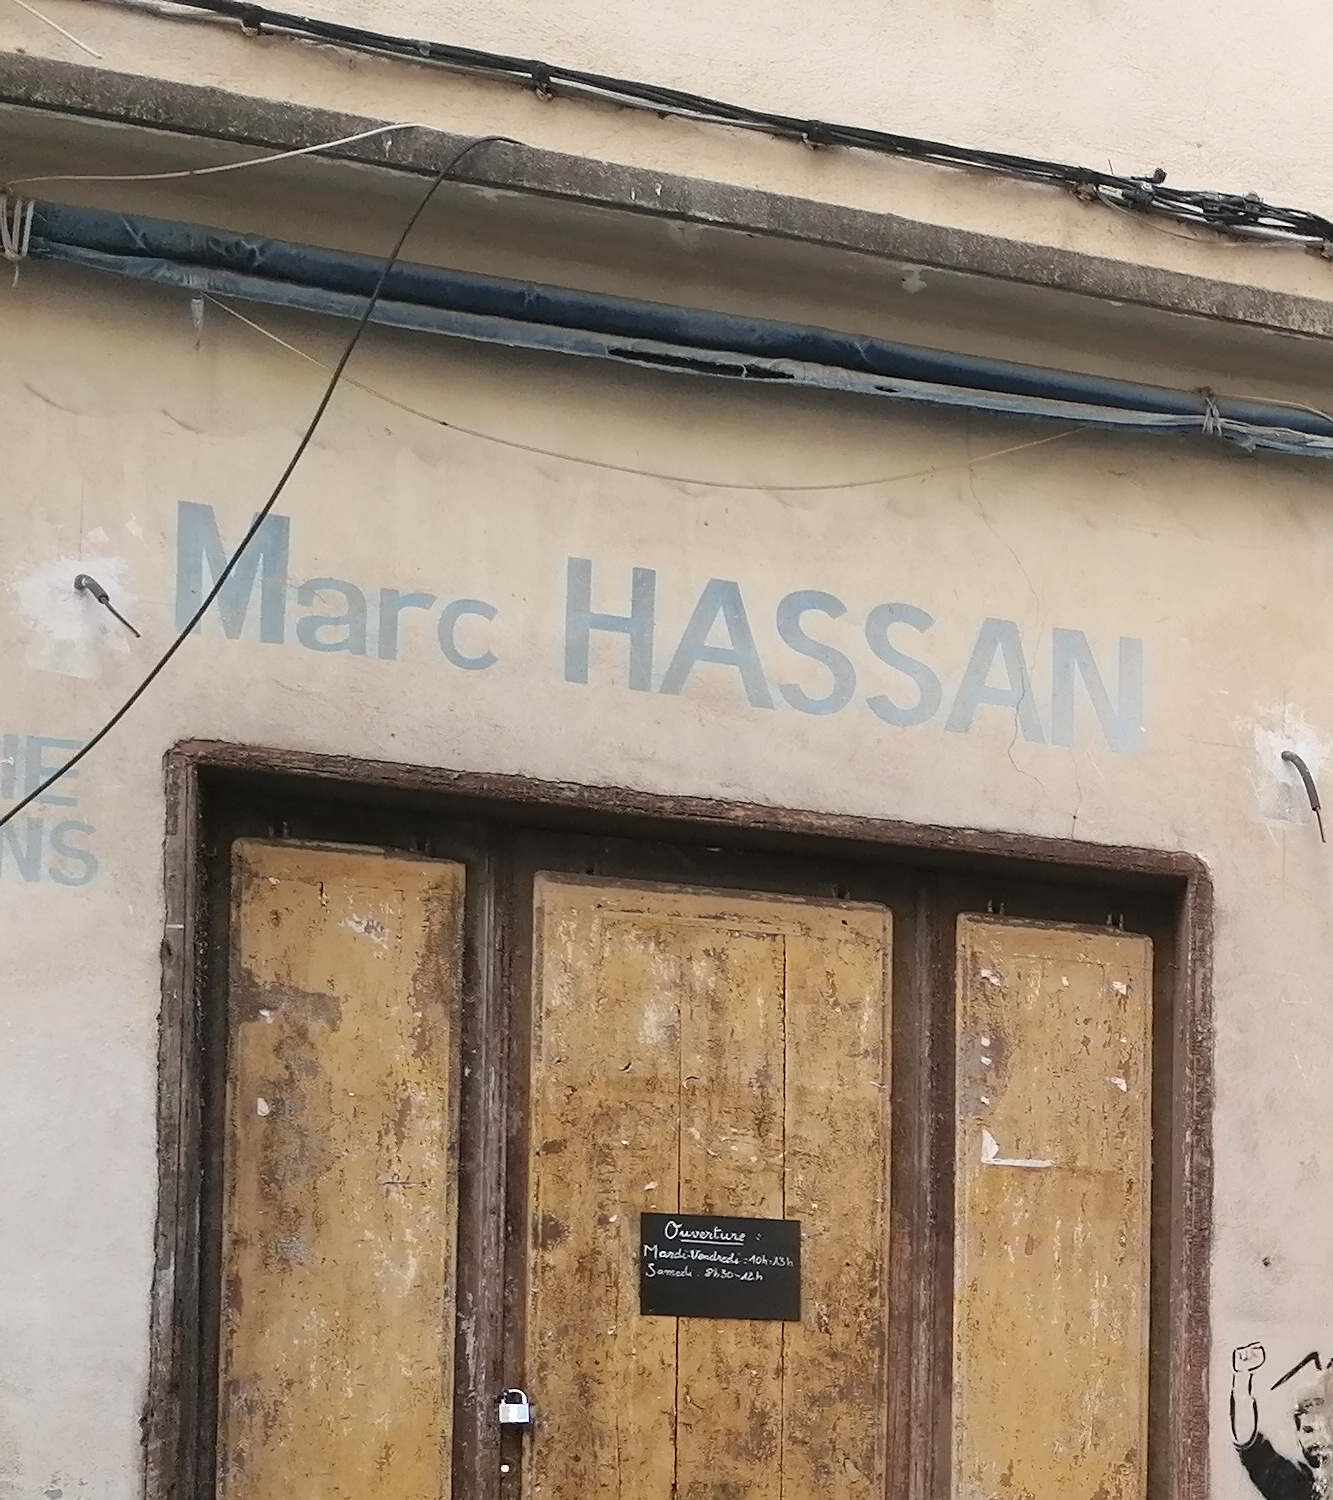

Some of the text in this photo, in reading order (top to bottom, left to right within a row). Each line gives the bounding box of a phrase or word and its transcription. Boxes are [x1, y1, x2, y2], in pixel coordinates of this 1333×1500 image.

[173, 500, 1146, 755] Marc HASSAN
[664, 1220, 747, 1243] Ouverture
[645, 1263, 693, 1278] Samedi
